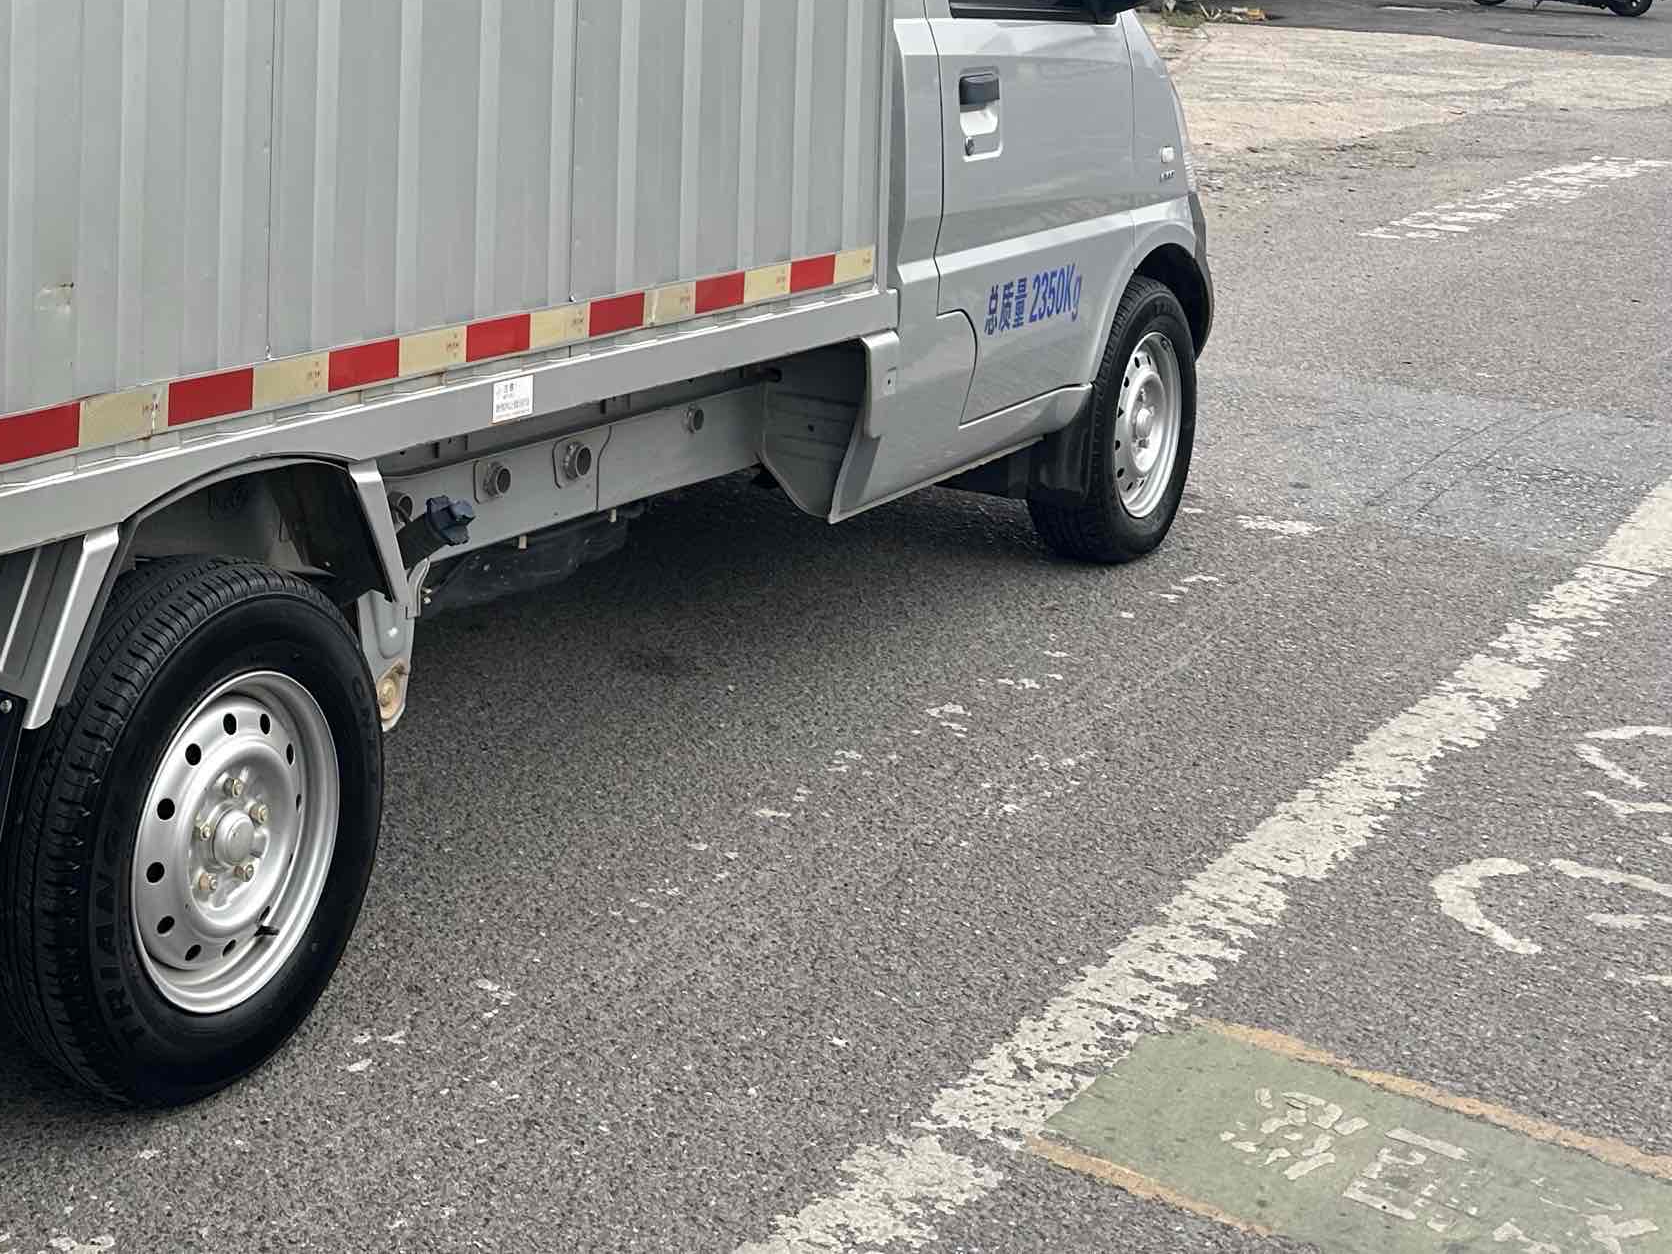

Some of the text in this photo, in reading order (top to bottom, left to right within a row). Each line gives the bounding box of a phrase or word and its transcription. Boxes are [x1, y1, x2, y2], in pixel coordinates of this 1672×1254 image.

[984, 262, 1082, 335] 总质量 2350Kg
